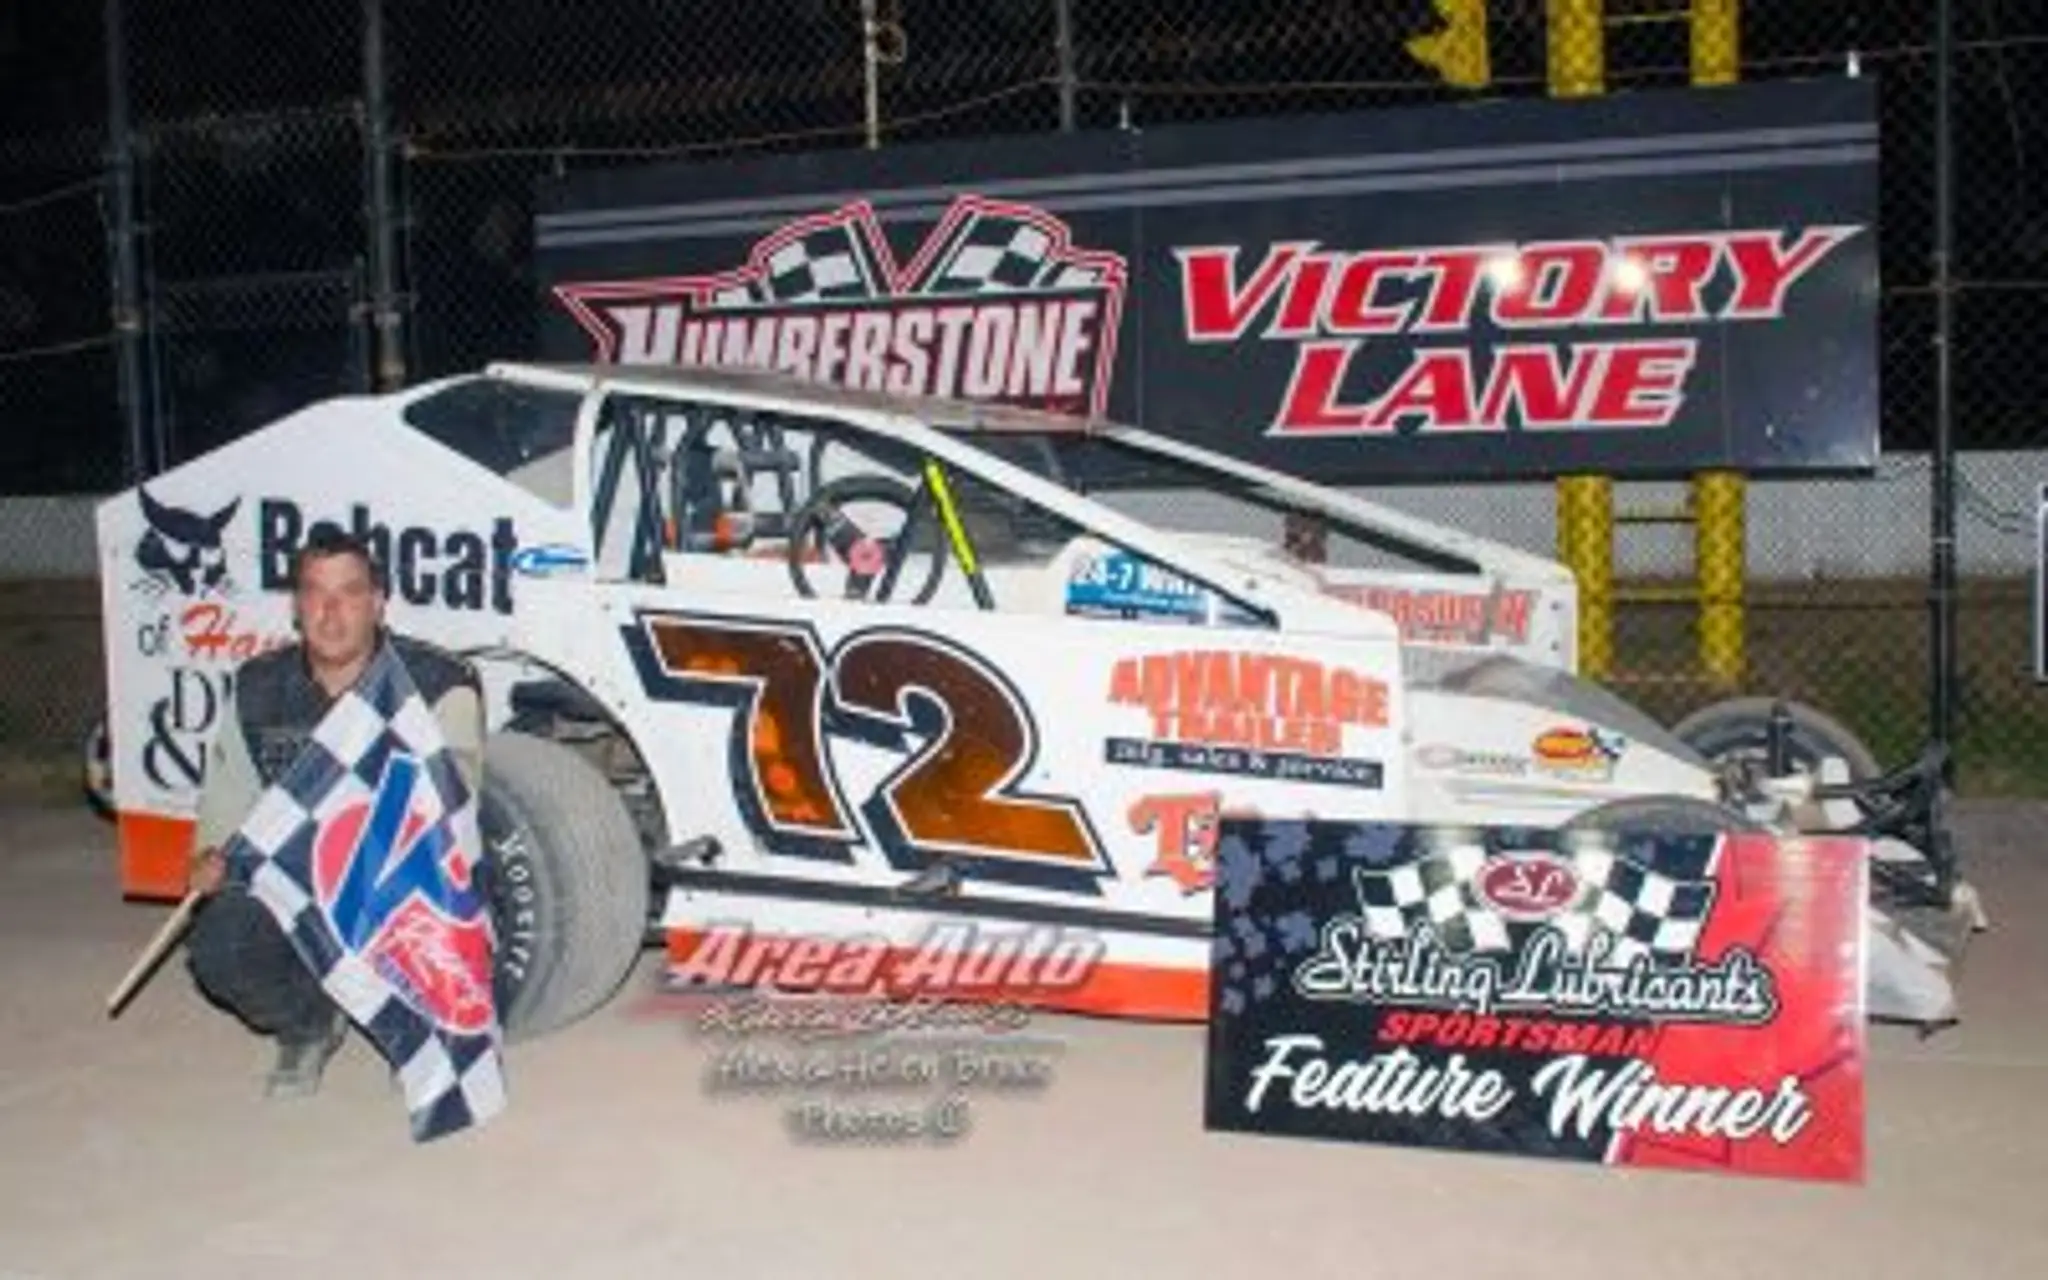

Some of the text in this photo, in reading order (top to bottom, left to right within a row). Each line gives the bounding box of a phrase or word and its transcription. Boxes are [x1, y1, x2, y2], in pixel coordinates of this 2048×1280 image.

[1173, 225, 1864, 343] VICTORY
[1265, 338, 1697, 437] LANE
[138, 614, 170, 657] of
[1108, 649, 1388, 727] ADVANTAGE
[1152, 708, 1342, 757] TRAILER
[622, 608, 1116, 896] 72
[1300, 922, 1774, 1018] Stirling Lubricants
[1378, 1010, 1657, 1057] SPORTSMAN
[1246, 1034, 1812, 1142] Feature Winner
